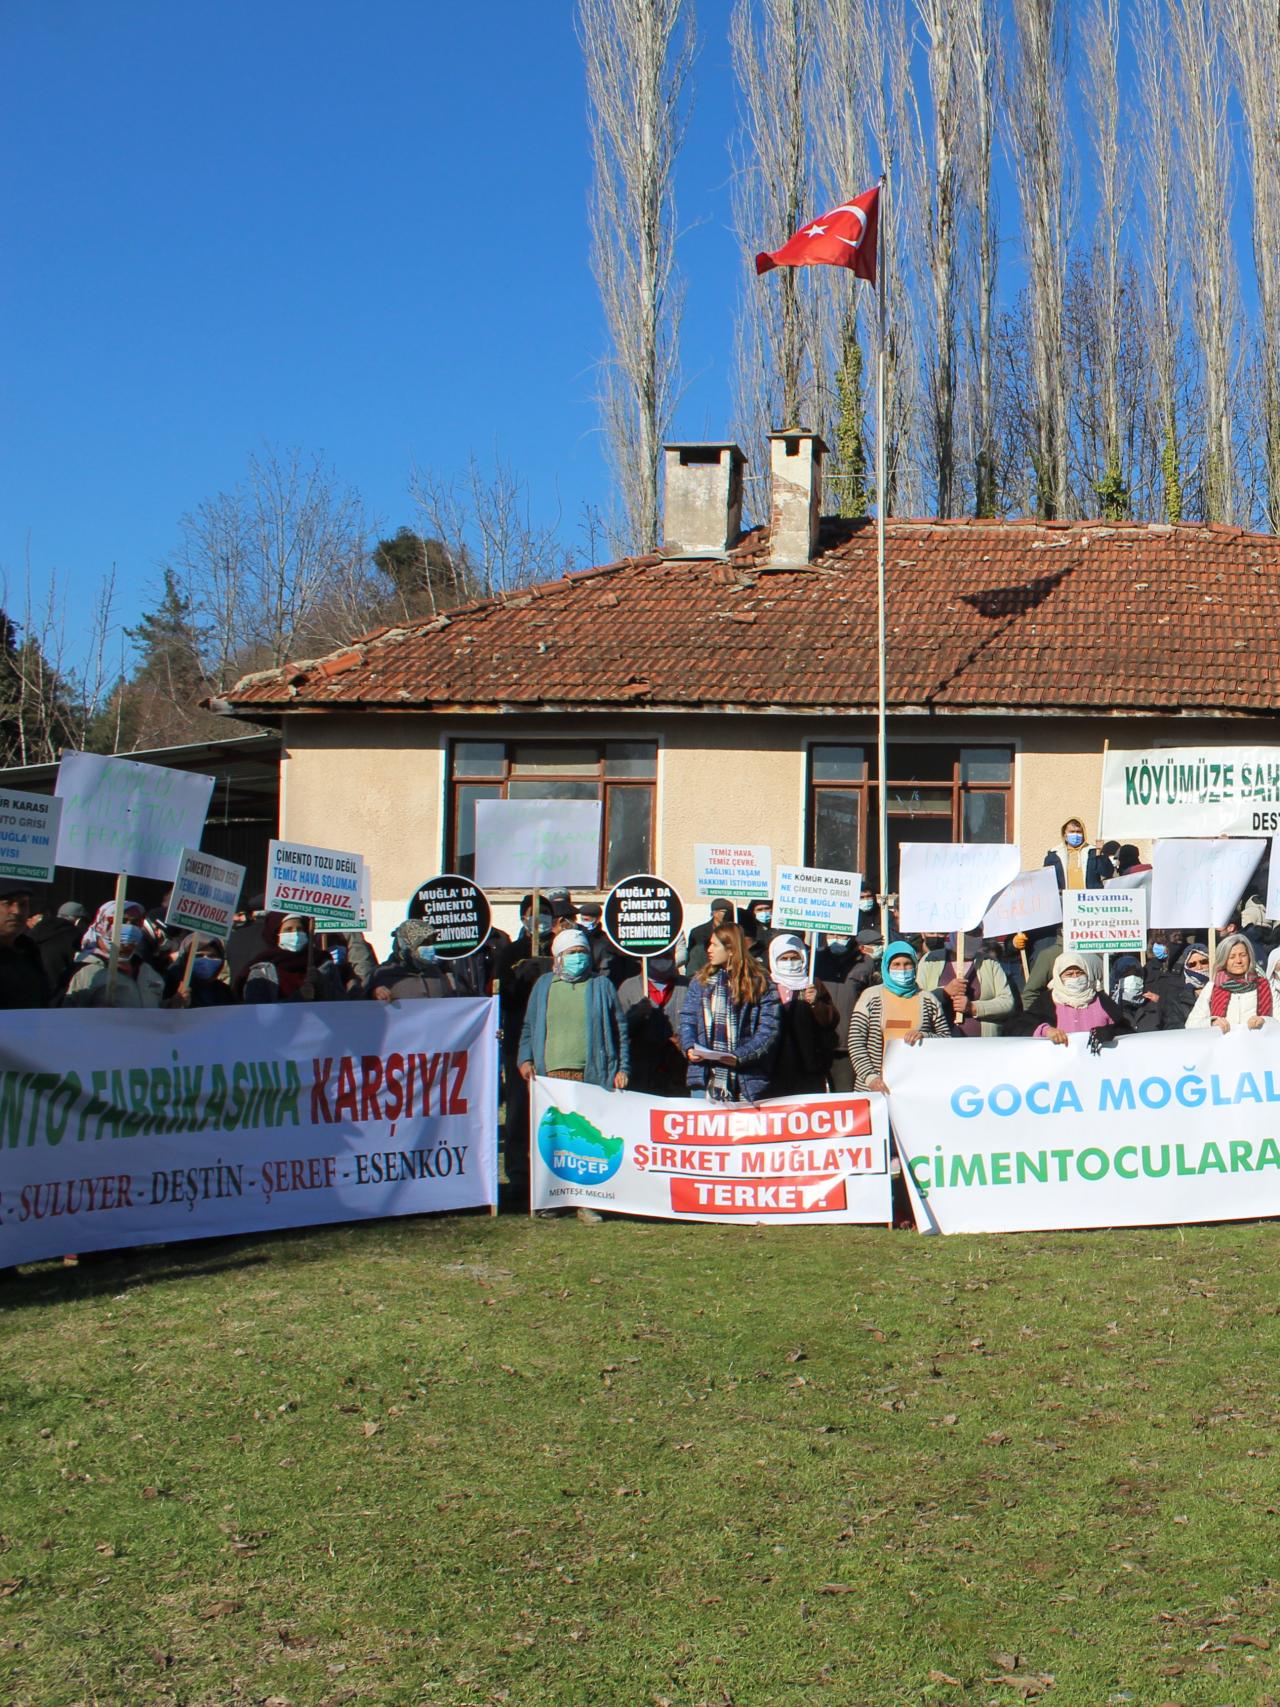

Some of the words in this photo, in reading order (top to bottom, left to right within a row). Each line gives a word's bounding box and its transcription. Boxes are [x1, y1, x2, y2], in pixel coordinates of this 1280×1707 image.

[1125, 758, 1235, 805] KÖYÜMÜZE
[711, 848, 733, 856] TEMİZ
[276, 848, 312, 867] ÇİMENTO
[314, 855, 334, 870] TOZU
[335, 857, 358, 875] DEĞİL
[708, 857, 731, 866] TEMİZ
[273, 866, 298, 883] TEMİZ
[299, 871, 320, 886] HAVA
[824, 876, 852, 886] KARASI
[275, 882, 353, 909] İSTİYORUZ.
[461, 886, 477, 897] DA
[657, 887, 671, 898] DA
[780, 884, 792, 892] NE
[620, 898, 668, 913] ÇİMENTO
[798, 897, 809, 905] DE
[839, 901, 854, 909] NIN
[1077, 893, 1133, 903] Havama,
[424, 899, 474, 916] ÇİMENTO
[422, 912, 478, 926] FABRİKASI
[617, 910, 671, 923] FABRİKASI
[1071, 918, 1140, 929] Toprağıma
[435, 925, 479, 942] EMİYORUZ!
[618, 923, 671, 939] İSTEMİYORUZ!
[1070, 929, 1141, 940] DOKUNMA!
[77, 1049, 301, 1143] FABRİKASINA
[310, 1050, 469, 1138] KARŞIYIZ
[950, 1078, 1085, 1119] GOCA
[662, 1108, 854, 1140] ÇİMENTOCU
[553, 1156, 609, 1176] MUÇEP
[632, 1144, 731, 1173] ŞİRKET
[741, 1144, 872, 1173] MUĞLA'YI
[18, 1173, 134, 1223] SULUYER
[149, 1157, 245, 1213] DEŞTİN
[260, 1156, 338, 1207] ŞEREF
[353, 1140, 470, 1187] ESENKÖY
[549, 1187, 585, 1197] MENTEŞE
[585, 1190, 616, 1200] MECLİSİ
